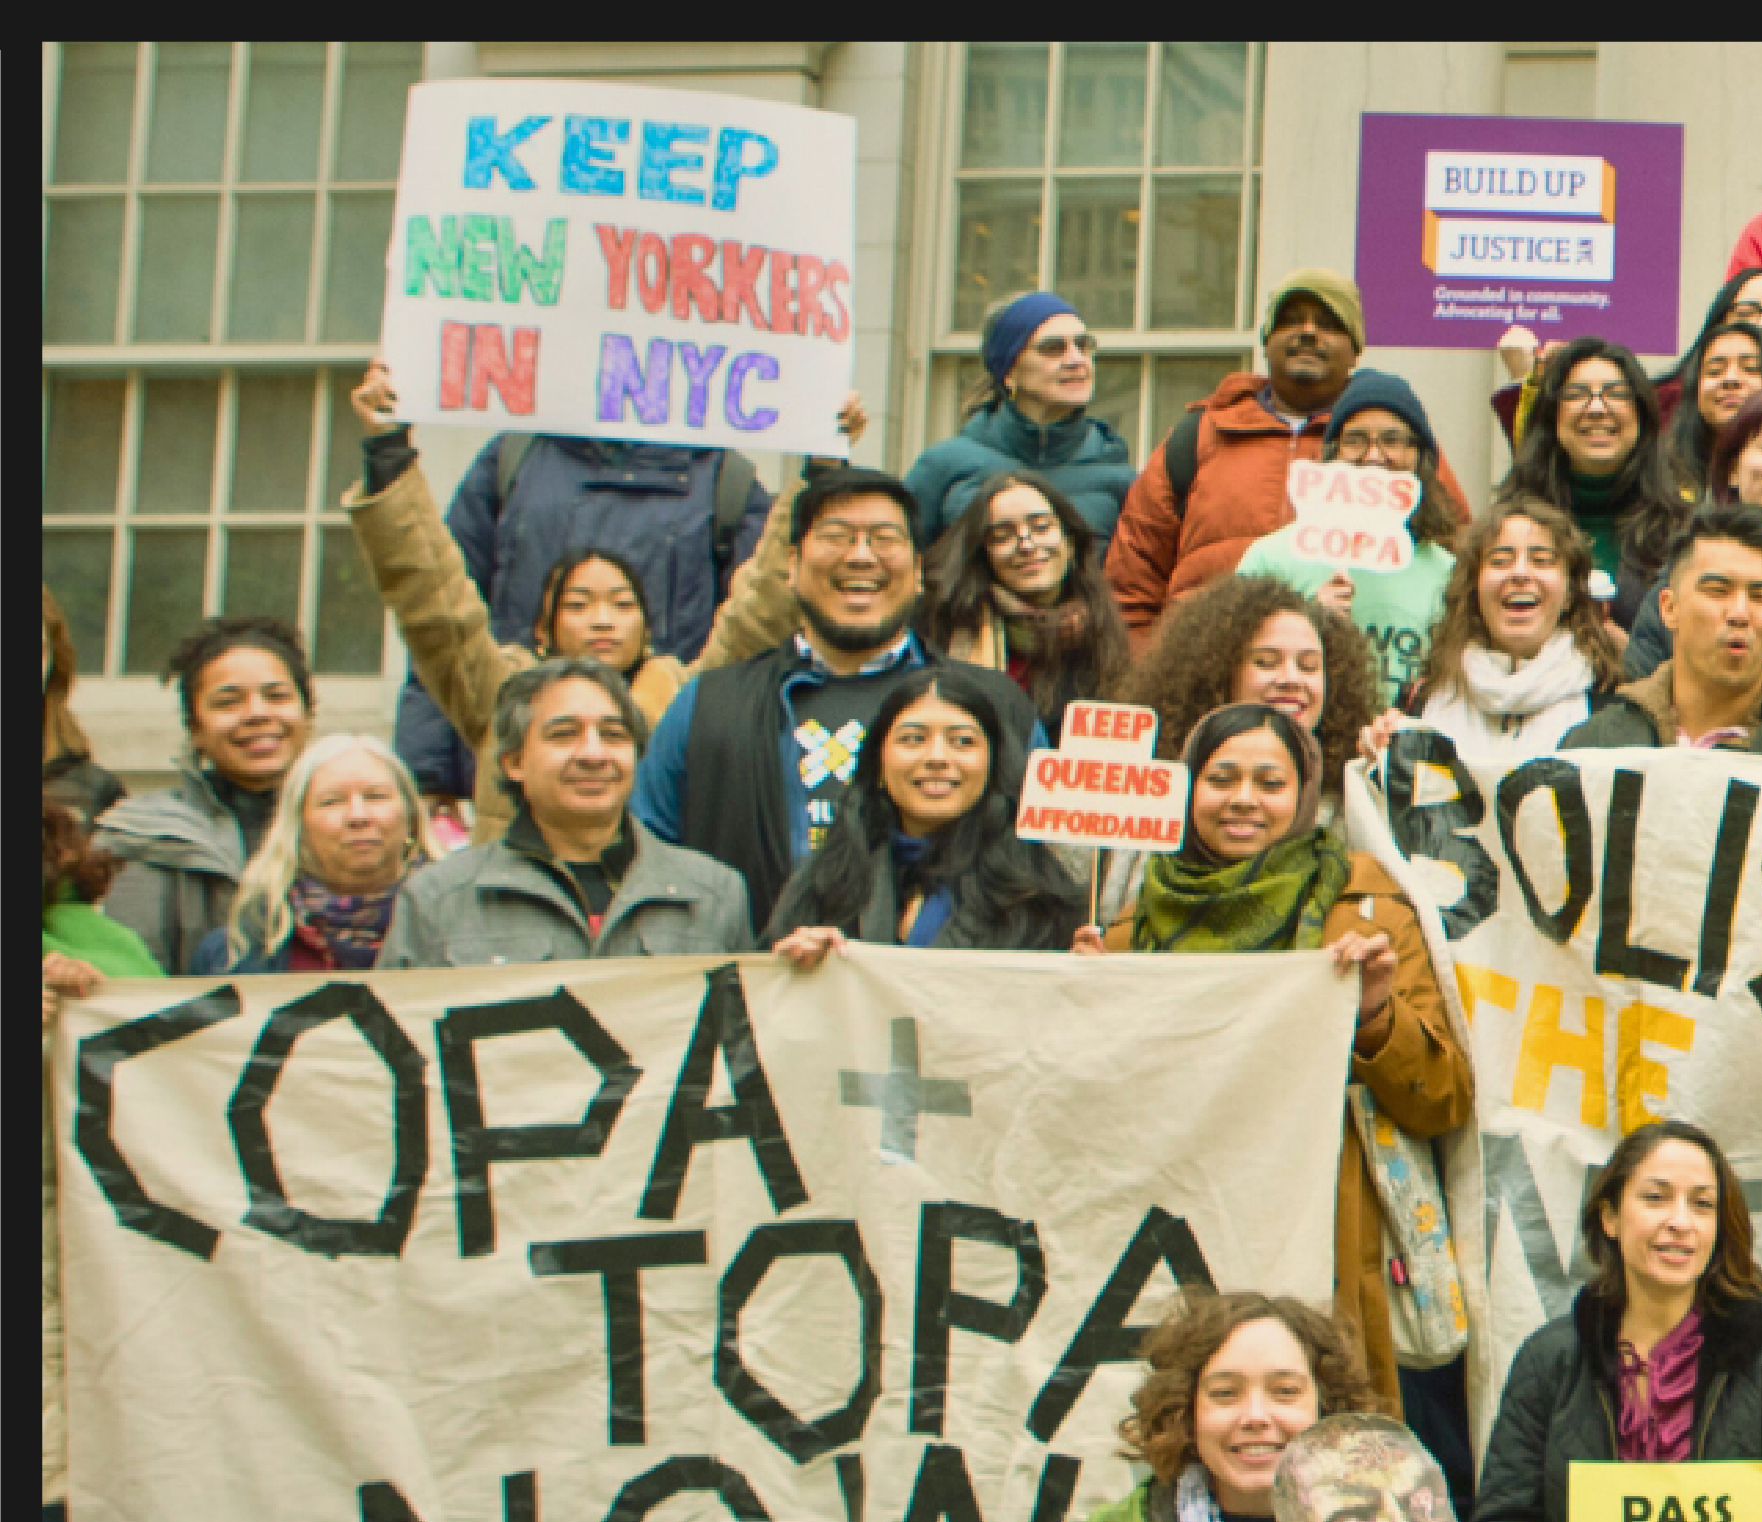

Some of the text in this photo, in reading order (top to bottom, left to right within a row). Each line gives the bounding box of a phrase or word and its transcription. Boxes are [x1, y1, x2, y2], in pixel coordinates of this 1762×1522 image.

[462, 114, 779, 211] KEEP
[1443, 166, 1586, 198] BUILD UP
[1450, 234, 1570, 263] JUSTICE
[405, 214, 851, 343] NEW YORKERS
[438, 321, 780, 432] IN NYC
[1295, 468, 1415, 511] PASS
[1295, 525, 1401, 566] COPA
[1070, 704, 1155, 743] KEEP
[1036, 757, 1172, 798] QUEENS
[1020, 805, 1184, 843] AFFORDABLE
[73, 962, 809, 1259] COPA
[529, 1200, 1218, 1458] TOPA
